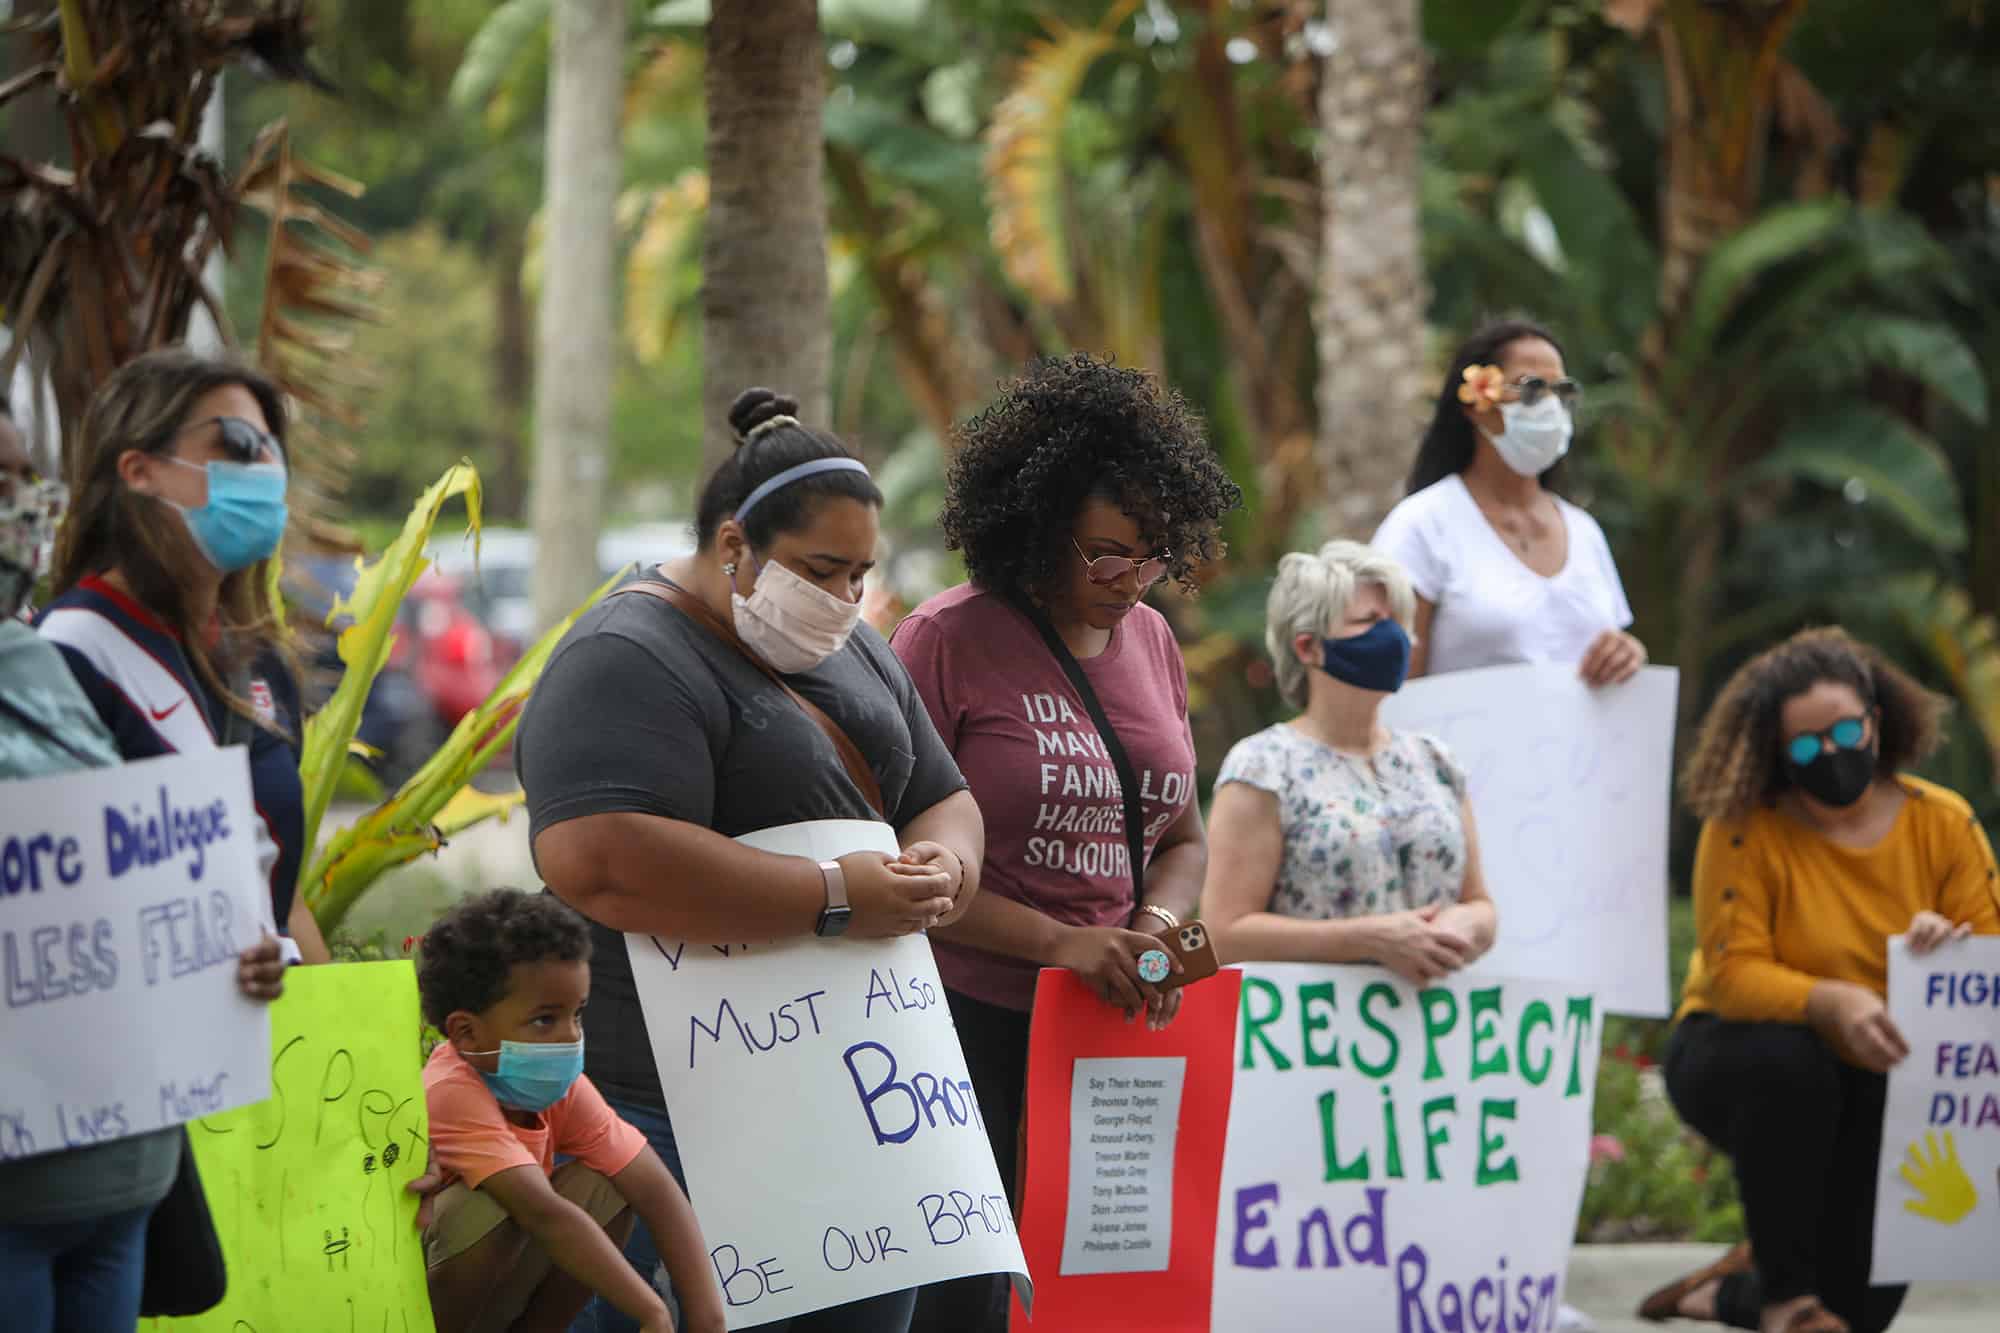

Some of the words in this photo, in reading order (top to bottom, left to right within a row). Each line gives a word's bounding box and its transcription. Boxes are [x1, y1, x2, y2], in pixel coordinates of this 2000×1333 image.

[1022, 694, 1079, 724] IDA
[0, 832, 83, 897] ore
[105, 785, 230, 880] Dialogue
[1034, 803, 1125, 833] HARRIE
[1144, 812, 1169, 836] &
[4, 918, 117, 1009] LESS
[139, 890, 241, 986] FEAR
[689, 990, 826, 1069] MUST
[866, 968, 936, 1018] ALSO
[1239, 975, 1594, 1100] RESPECT
[1935, 1042, 2000, 1077] FEA
[842, 1041, 982, 1146] BROT
[1089, 1077, 1105, 1091] Say
[1928, 1093, 2000, 1129] DIA
[711, 1243, 794, 1306] BE
[823, 1225, 907, 1273] OUR
[917, 1190, 1012, 1245] BROT
[1232, 1181, 1389, 1270] End
